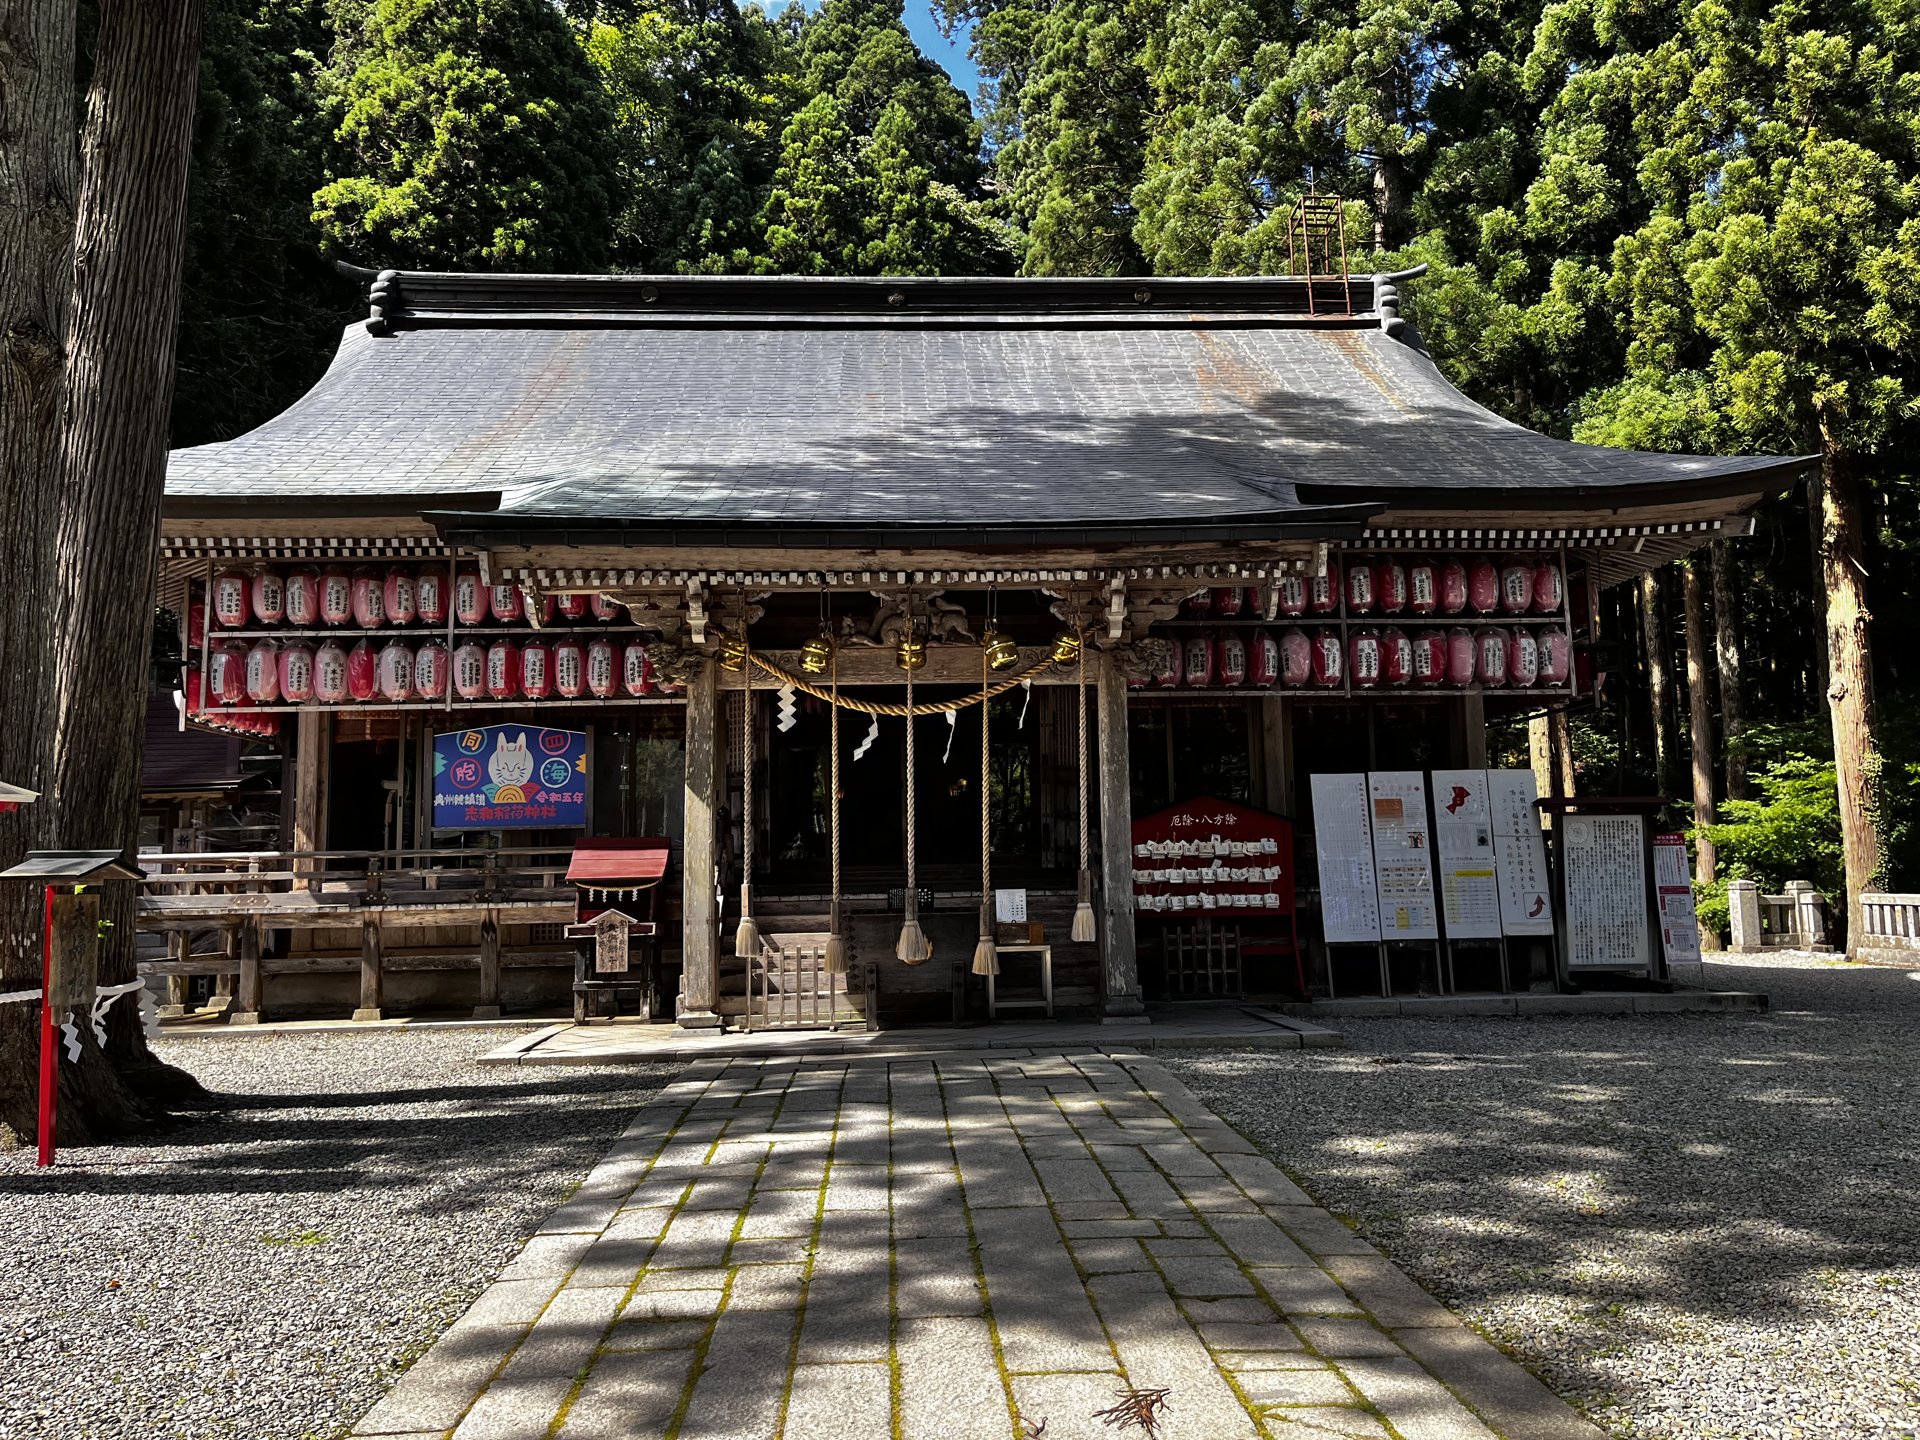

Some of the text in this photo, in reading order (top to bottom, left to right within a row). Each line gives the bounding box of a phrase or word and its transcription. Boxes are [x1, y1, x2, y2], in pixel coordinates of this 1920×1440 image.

[462, 731, 482, 751] 同
[545, 763, 567, 782] 海
[535, 791, 584, 804] 令和五年
[464, 804, 557, 822] 志和稲荷神社
[1170, 812, 1238, 827] 厄除・八方除
